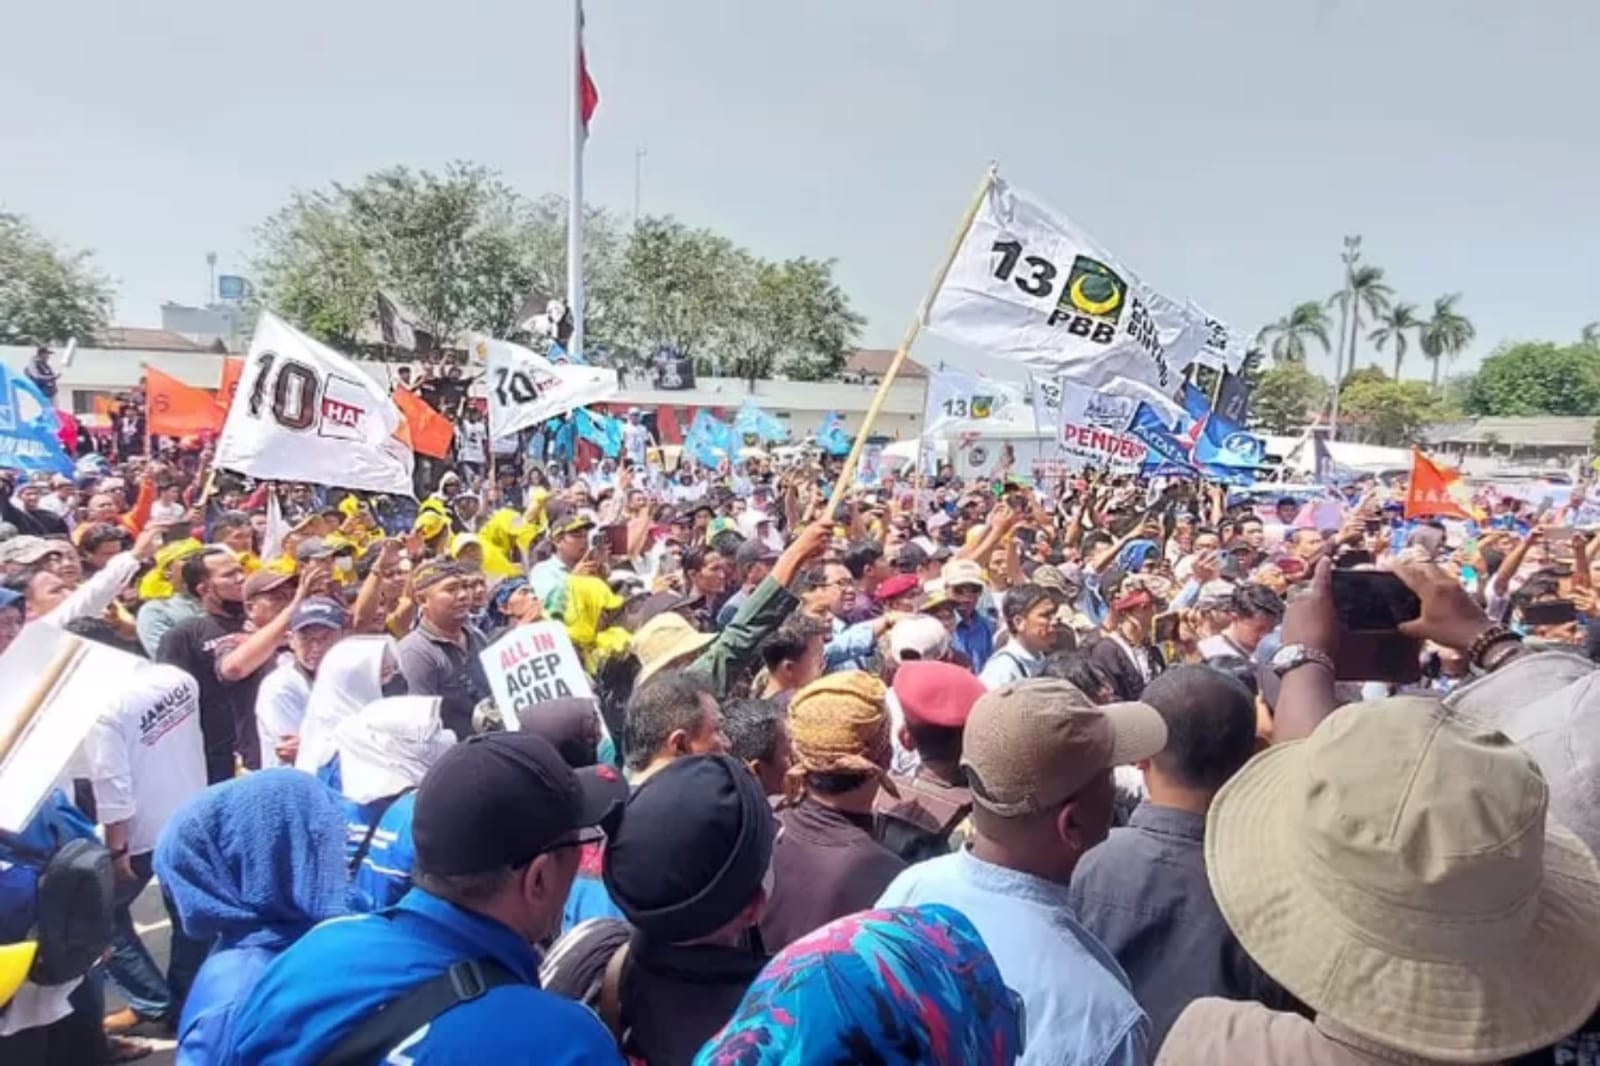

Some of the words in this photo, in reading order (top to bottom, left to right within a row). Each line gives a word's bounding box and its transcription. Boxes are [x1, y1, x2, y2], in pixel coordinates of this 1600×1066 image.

[992, 240, 1057, 297] 13
[1048, 309, 1115, 344] PBB
[248, 351, 322, 434] 10
[495, 367, 538, 406] 10
[943, 399, 967, 417] 13
[501, 641, 529, 669] ALL
[533, 633, 555, 653] IN
[506, 653, 561, 698] ACEP
